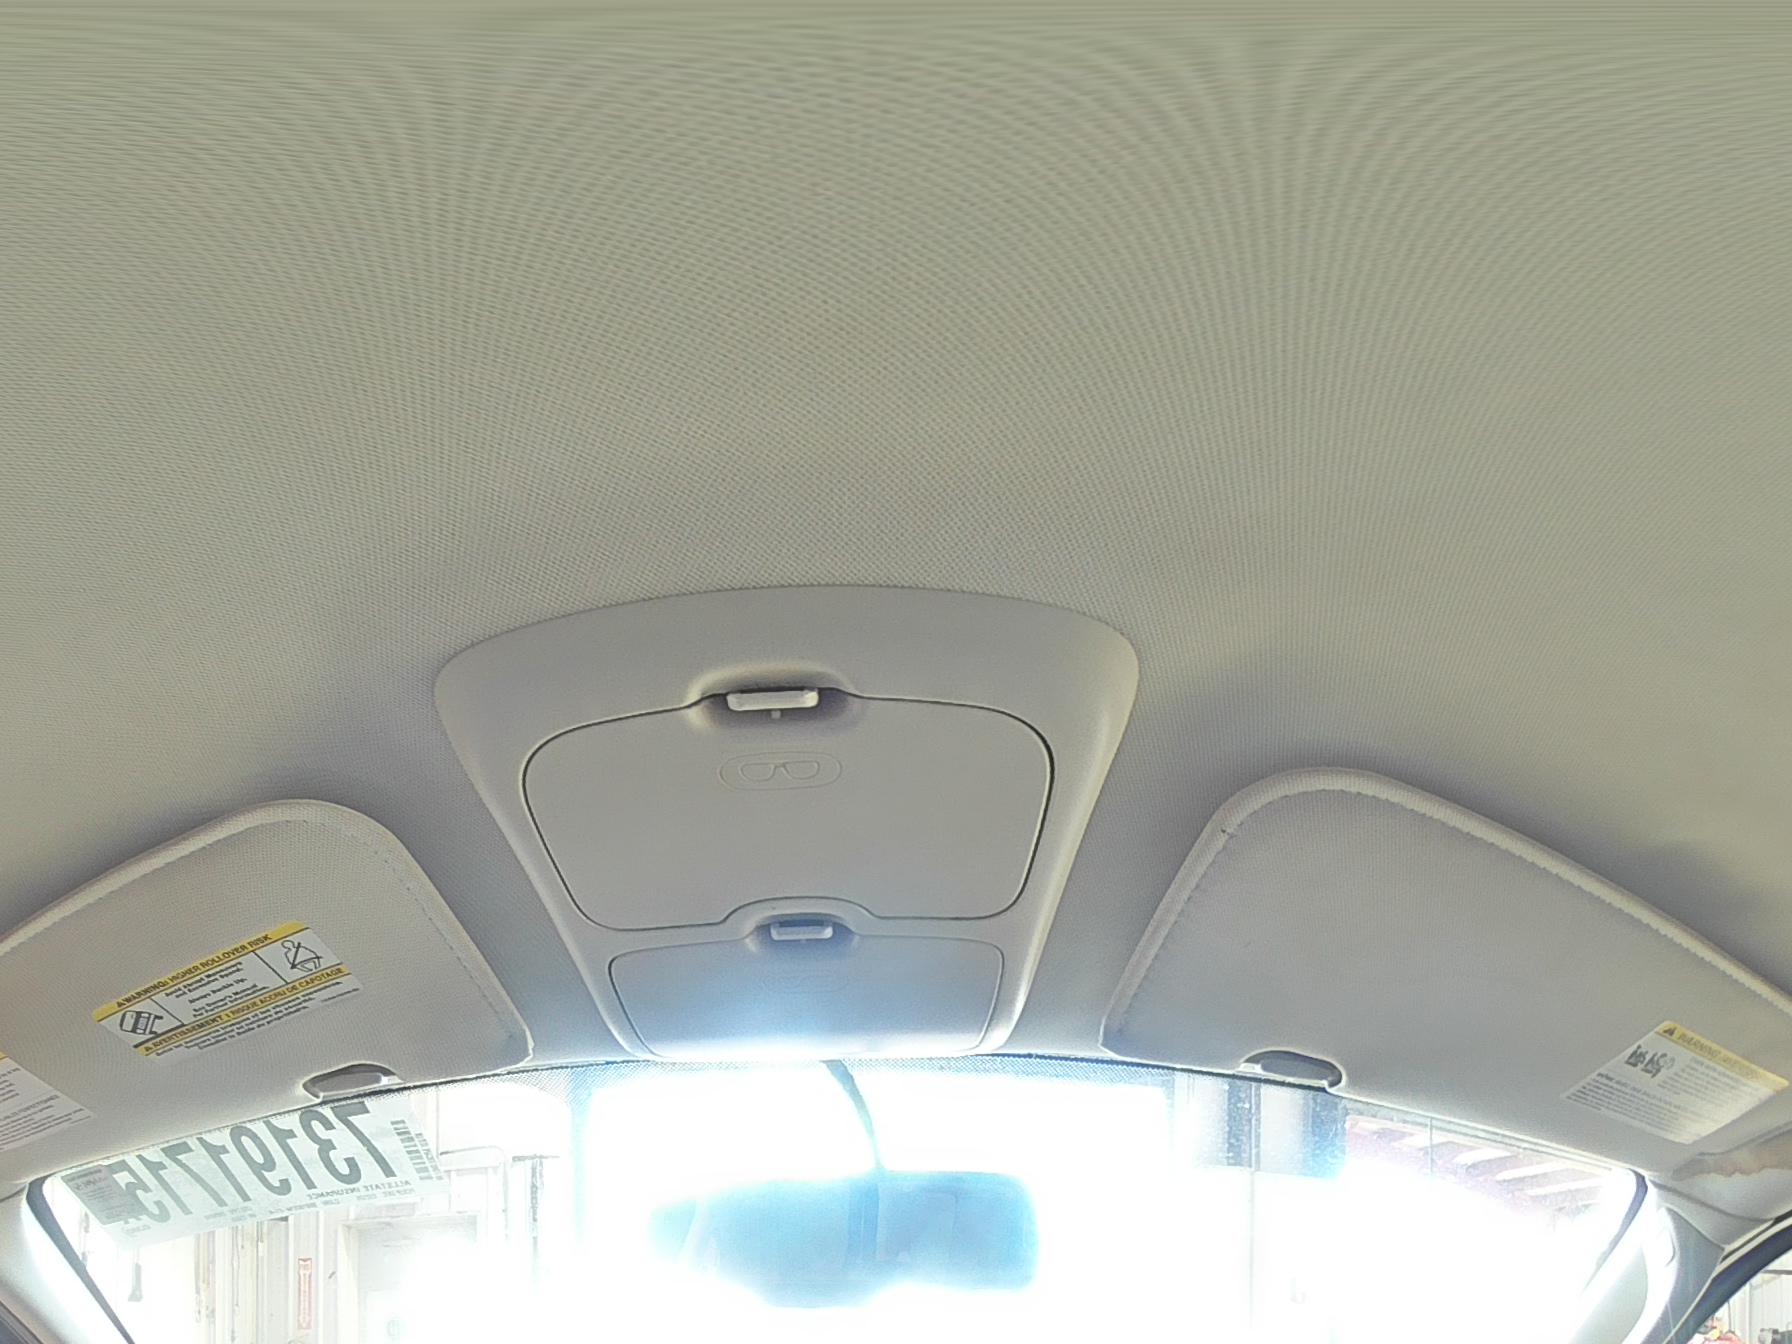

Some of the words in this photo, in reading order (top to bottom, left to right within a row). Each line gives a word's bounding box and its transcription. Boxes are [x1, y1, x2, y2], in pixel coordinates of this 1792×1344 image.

[170, 965, 203, 983] HIGHER
[199, 944, 249, 969] ROLLOVER
[247, 933, 272, 949] RISK
[298, 967, 344, 988] CAPOTAGE
